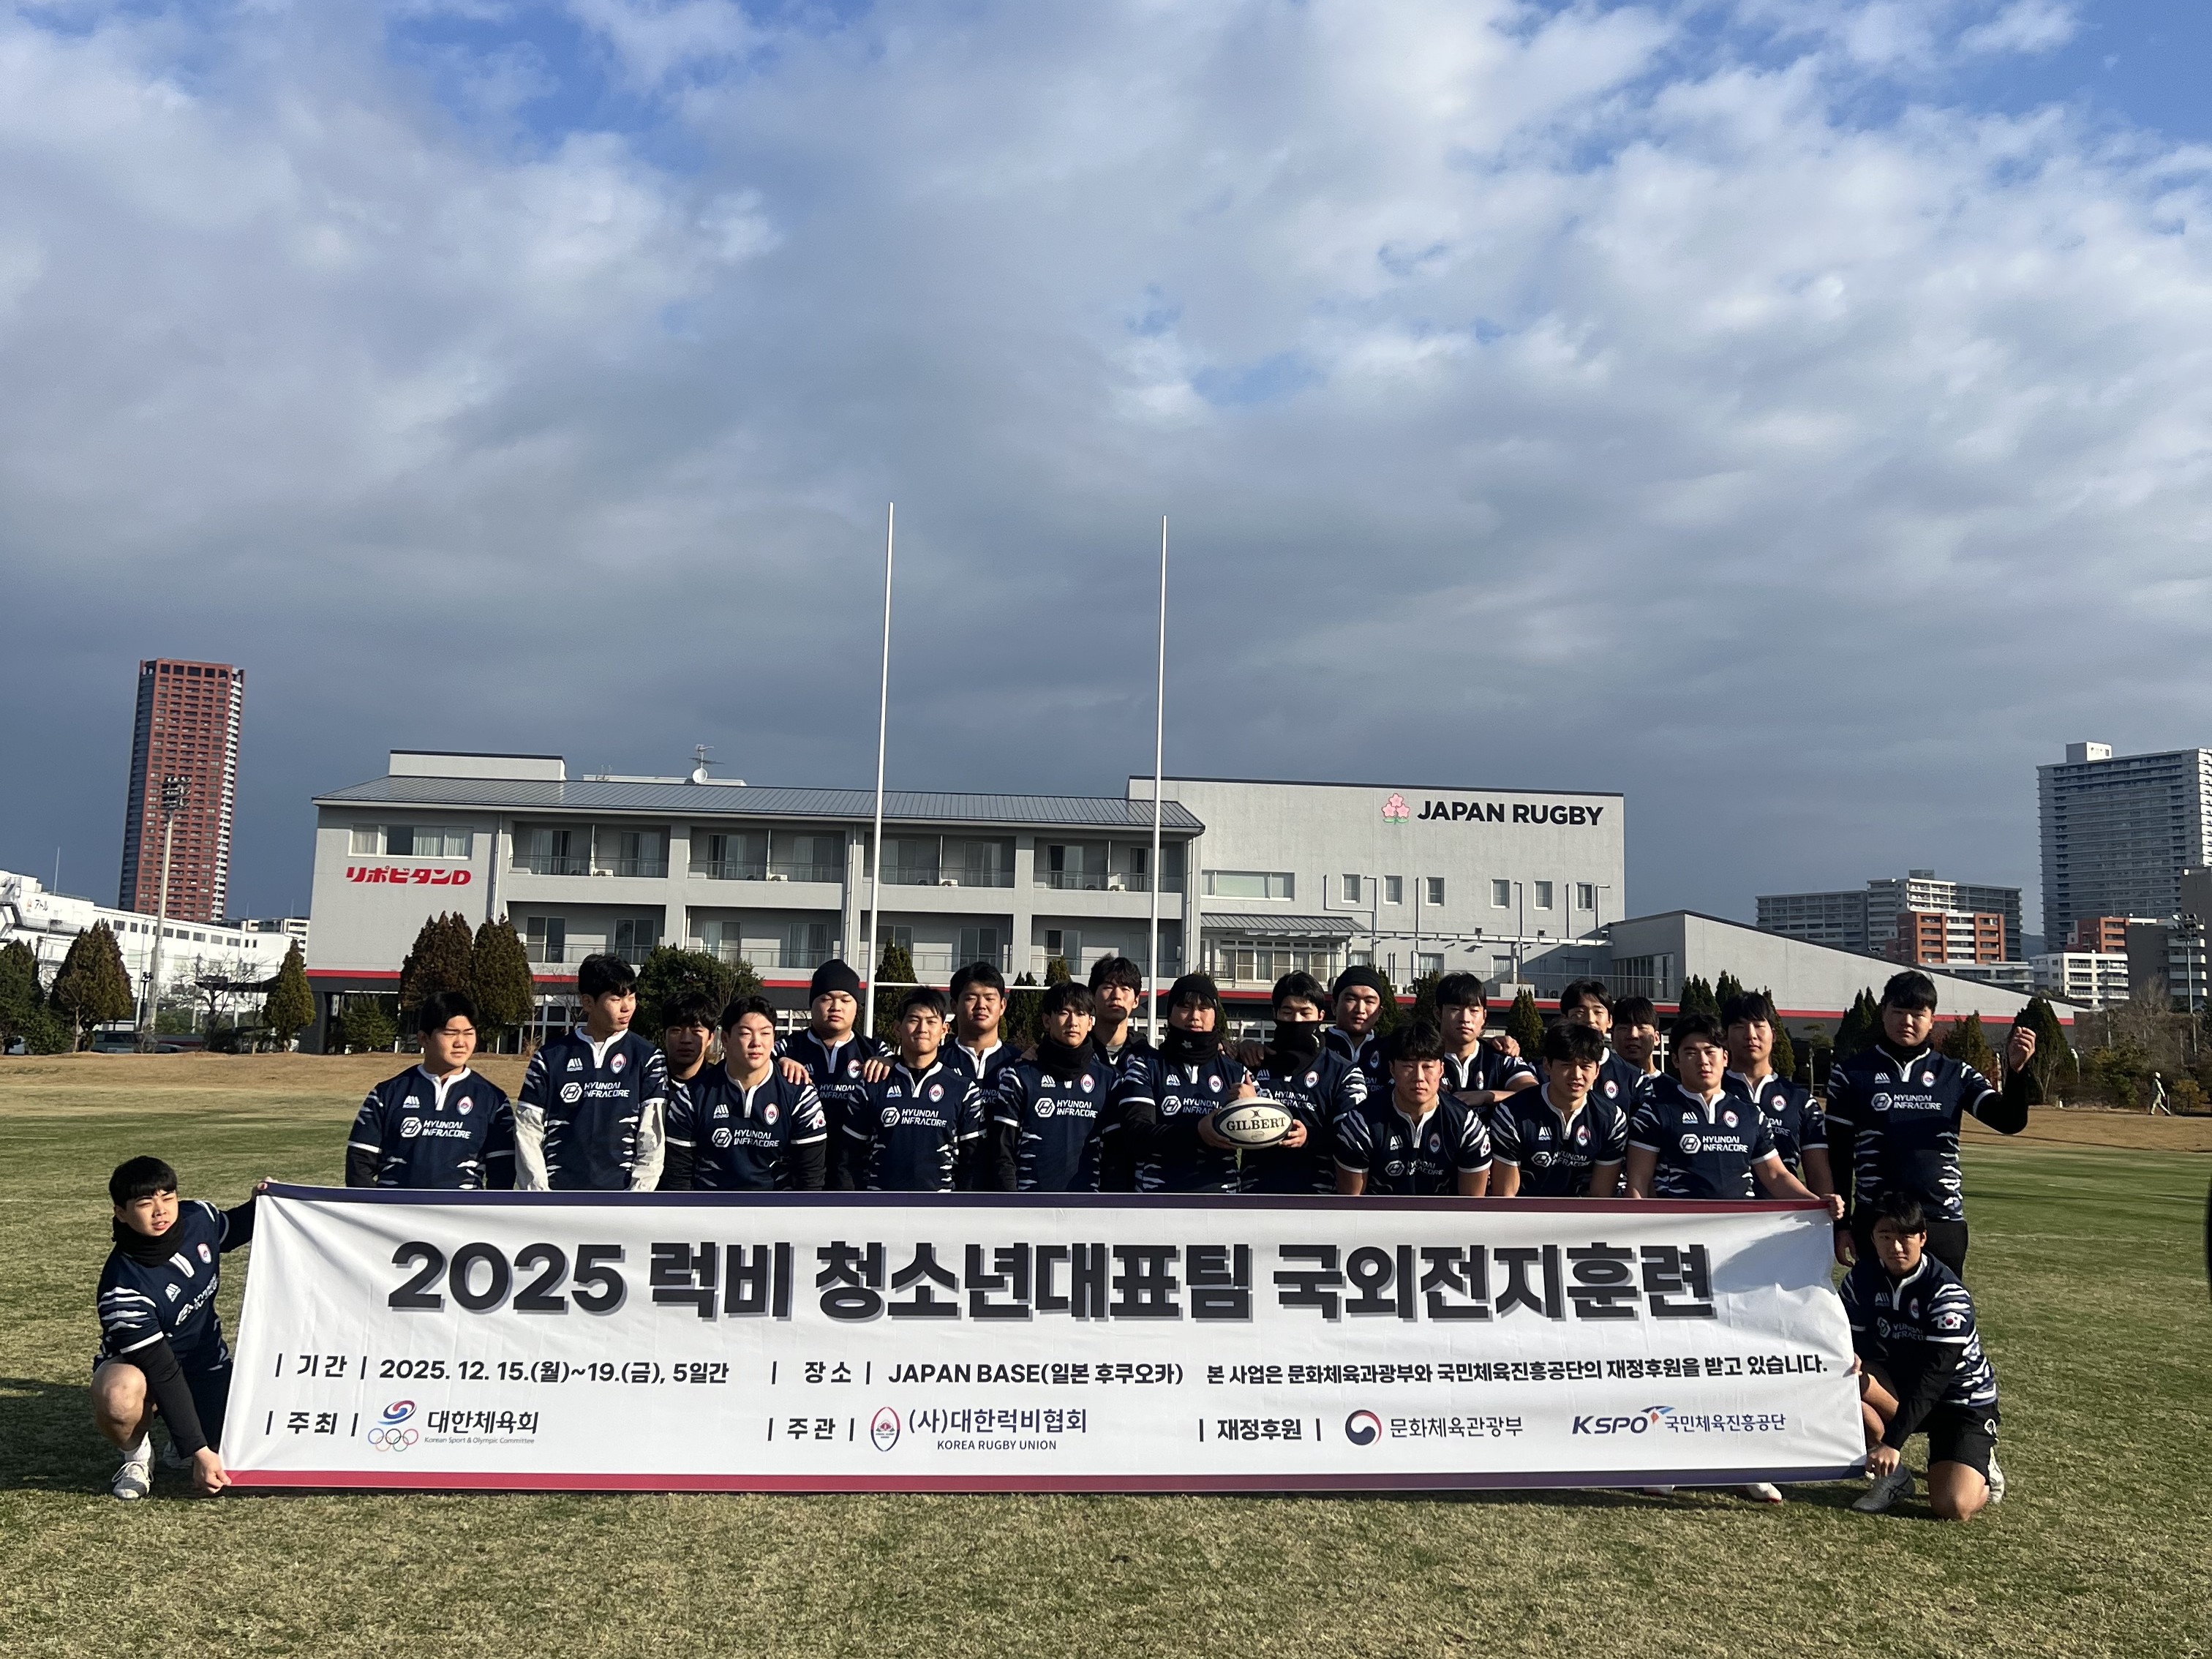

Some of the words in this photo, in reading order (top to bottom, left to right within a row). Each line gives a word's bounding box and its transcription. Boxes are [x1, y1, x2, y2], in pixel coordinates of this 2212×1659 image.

[1417, 800, 1505, 822] JAPAN
[1513, 804, 1603, 826] RUGBY
[346, 865, 471, 885] リポビタンD
[584, 1081, 621, 1090] HYUNDAI
[583, 1089, 630, 1098] INFRACORE
[820, 1091, 852, 1099] INFRAC
[1275, 1091, 1309, 1101] HYUNDAI
[1894, 1094, 1932, 1102] HYUNDAI
[1057, 1099, 1092, 1108] HYUNDAI
[1183, 1098, 1219, 1108] HYUNDAI
[1893, 1102, 1942, 1110] INFRACORE
[902, 1108, 939, 1118] HYUNDAI
[1056, 1108, 1098, 1118] INFRACORE
[1183, 1106, 1213, 1115] INFRAC
[423, 1120, 464, 1129] HYUNDAI
[901, 1117, 947, 1128] INFRACORE
[1226, 1117, 1286, 1131] GILBERT
[422, 1129, 472, 1139] INFRACORE
[734, 1129, 772, 1139] HYUNDAI
[1703, 1135, 1740, 1143] HYUNDAI
[734, 1137, 780, 1148] INFRACORE
[1703, 1143, 1749, 1154] INFRACORE
[388, 1241, 628, 1313] 2025
[650, 1242, 793, 1320] 럭비
[816, 1241, 1251, 1320] 청소년대표팀
[1274, 1242, 1716, 1320] 국외전지훈련
[297, 1355, 347, 1377] 기간
[379, 1359, 450, 1380] 2025.
[458, 1361, 489, 1380] 12.
[497, 1361, 666, 1383] 15.(월)~19.(금),
[673, 1362, 729, 1383] 5일간
[805, 1361, 851, 1383] 장소
[888, 1363, 971, 1382] JAPAN
[977, 1363, 1090, 1384] BASE(일본
[1095, 1363, 1184, 1385] 후쿠오카)
[1207, 1365, 1224, 1384] 본
[1229, 1365, 1283, 1384] 사업은
[1287, 1363, 1432, 1384] 문화체육과광부와
[1437, 1360, 1602, 1382] 국민체육진흥공단의
[1606, 1357, 1701, 1379] 재정후원을
[1704, 1356, 1743, 1377] 받고
[1748, 1354, 1828, 1374] 있습니다.
[287, 1411, 338, 1435] 주최
[428, 1410, 539, 1434] 대한체육회
[787, 1418, 835, 1440] 주관
[909, 1409, 1086, 1434] (사)대한럭비협회
[1572, 1416, 1648, 1434] KSPO
[1665, 1413, 1786, 1433] 국민체육진흥공단
[1217, 1418, 1302, 1440] 재정후원
[1390, 1417, 1523, 1437] 문화체육관광부
[937, 1440, 976, 1450] KOREA
[979, 1440, 1016, 1451] RUGBY
[1020, 1440, 1056, 1451] UNION
